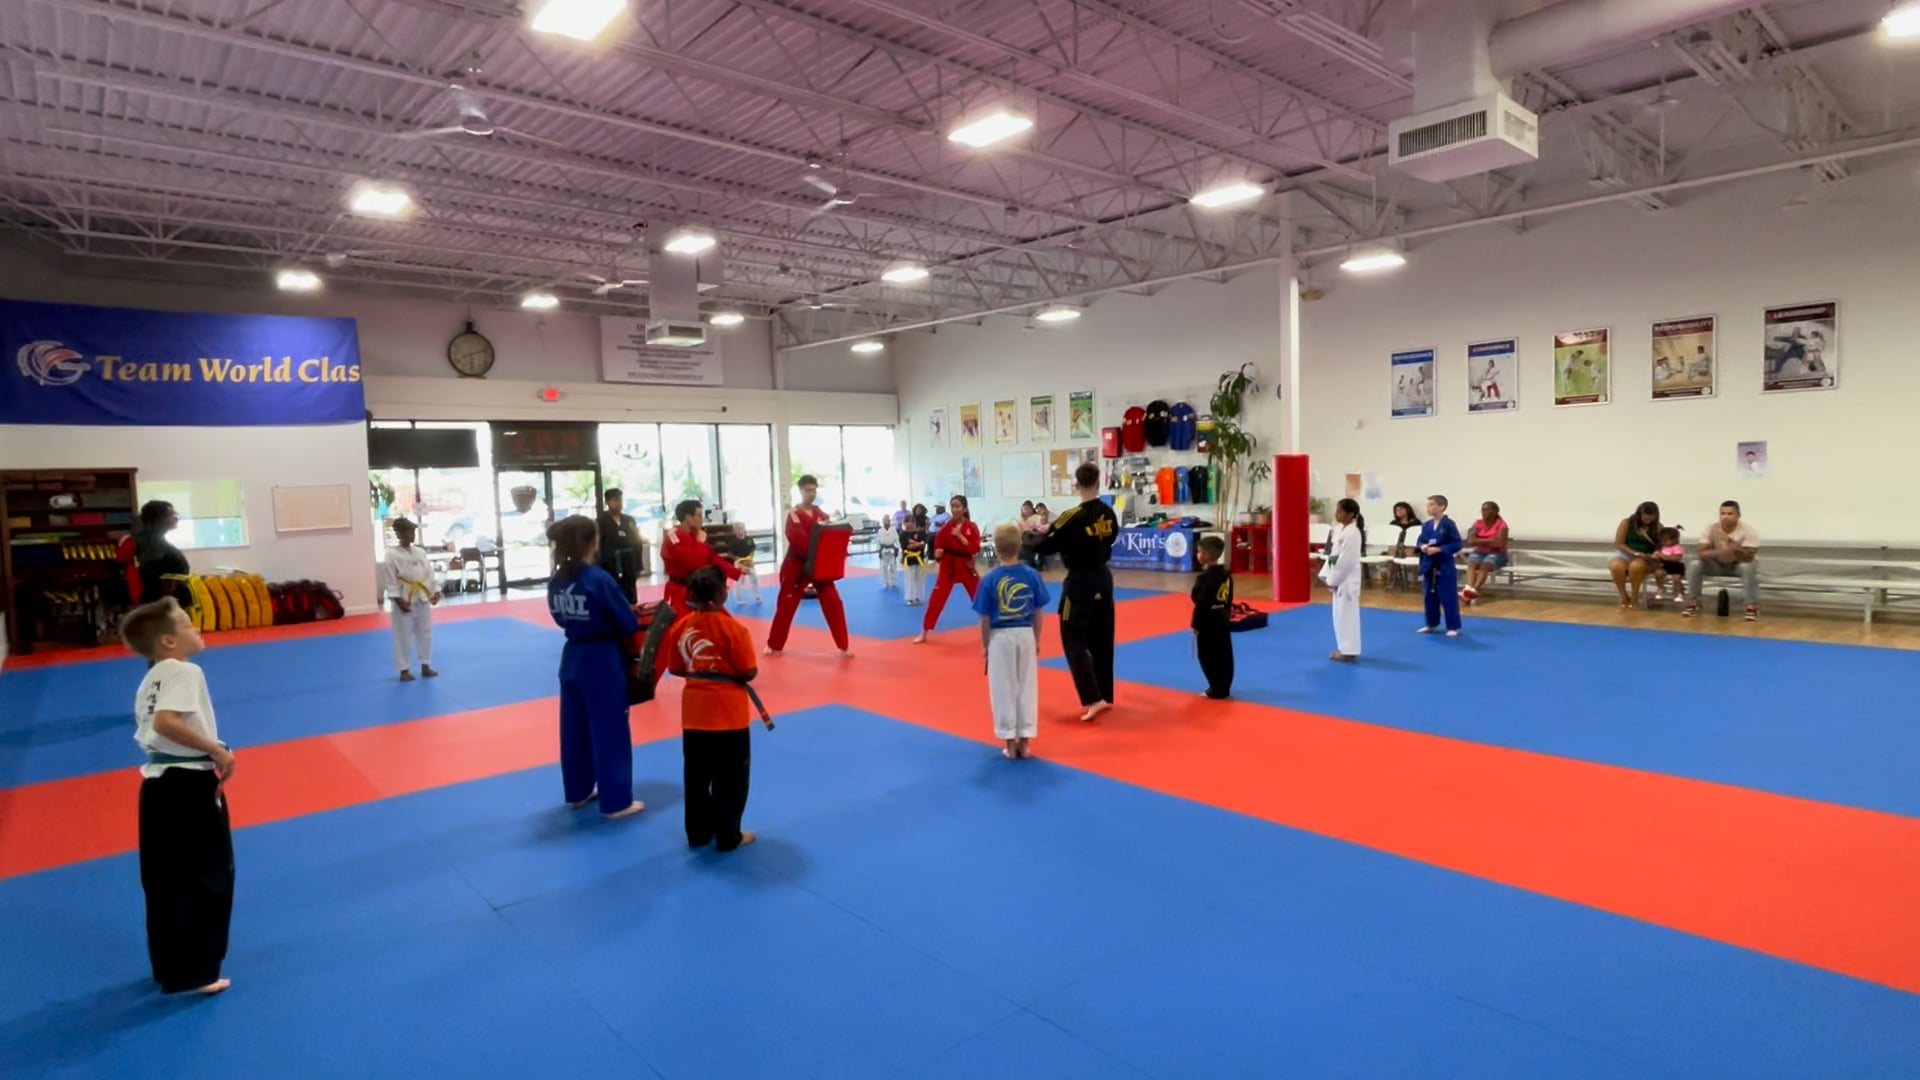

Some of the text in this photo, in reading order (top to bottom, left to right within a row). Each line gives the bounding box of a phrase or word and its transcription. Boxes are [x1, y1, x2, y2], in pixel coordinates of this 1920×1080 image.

[95, 355, 192, 382] Team
[199, 356, 292, 383] World
[1121, 532, 1166, 556] Kim's
